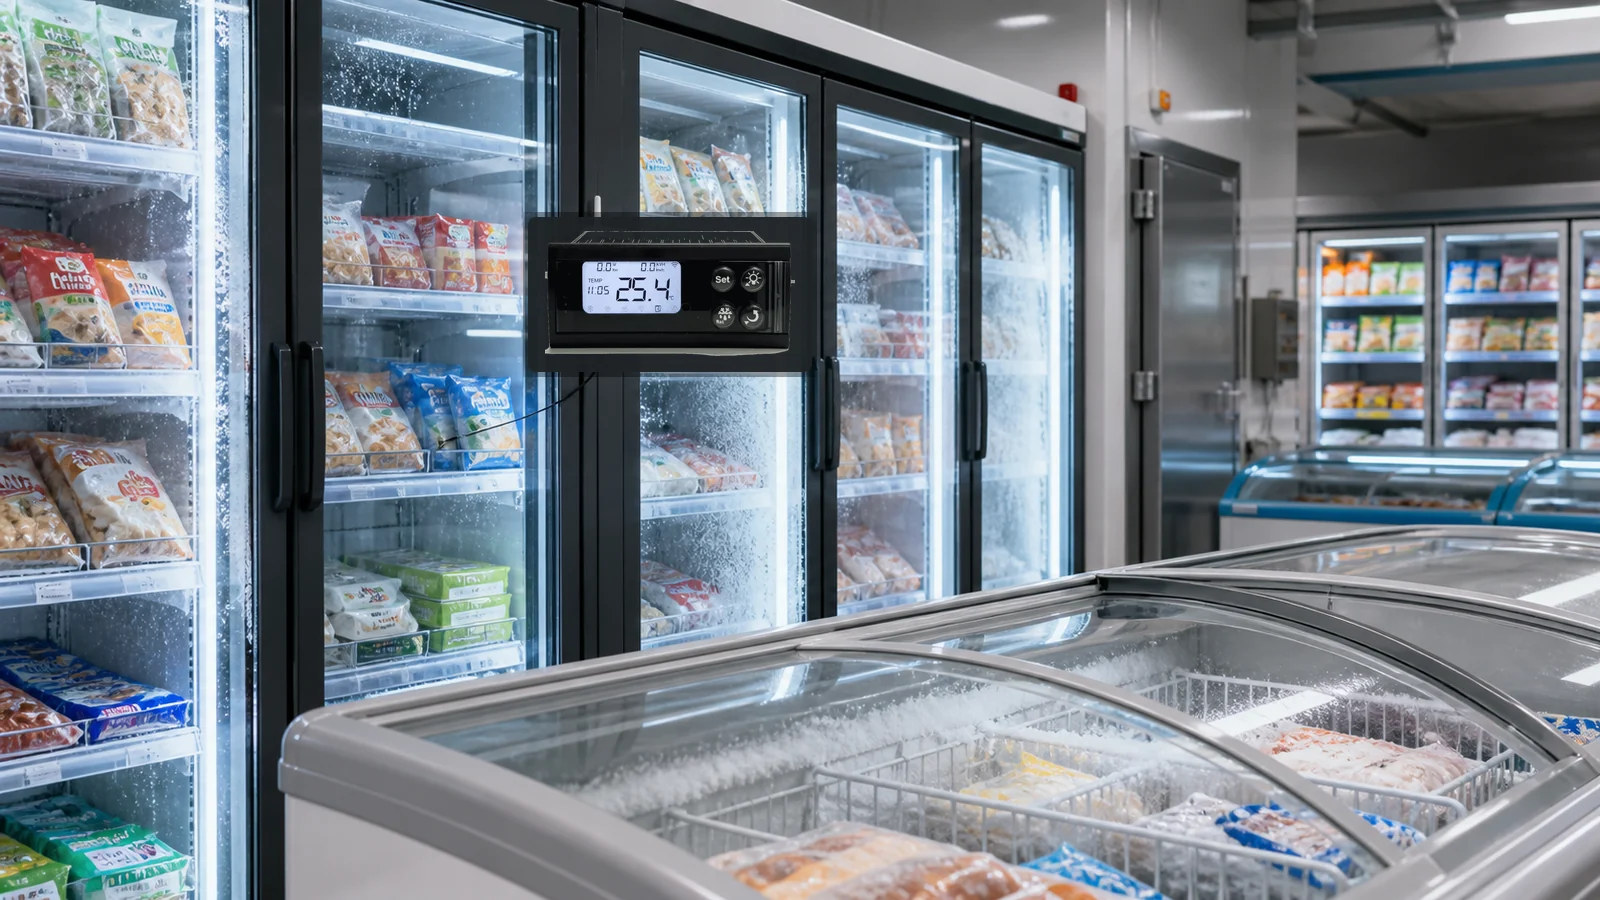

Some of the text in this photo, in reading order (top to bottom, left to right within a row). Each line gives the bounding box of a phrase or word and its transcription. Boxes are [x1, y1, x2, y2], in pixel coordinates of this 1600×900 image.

[596, 262, 612, 272] 0.0
[640, 262, 656, 272] 0.0
[715, 275, 731, 284] Set
[587, 285, 610, 295] 11:05
[616, 277, 671, 302] 25.4
